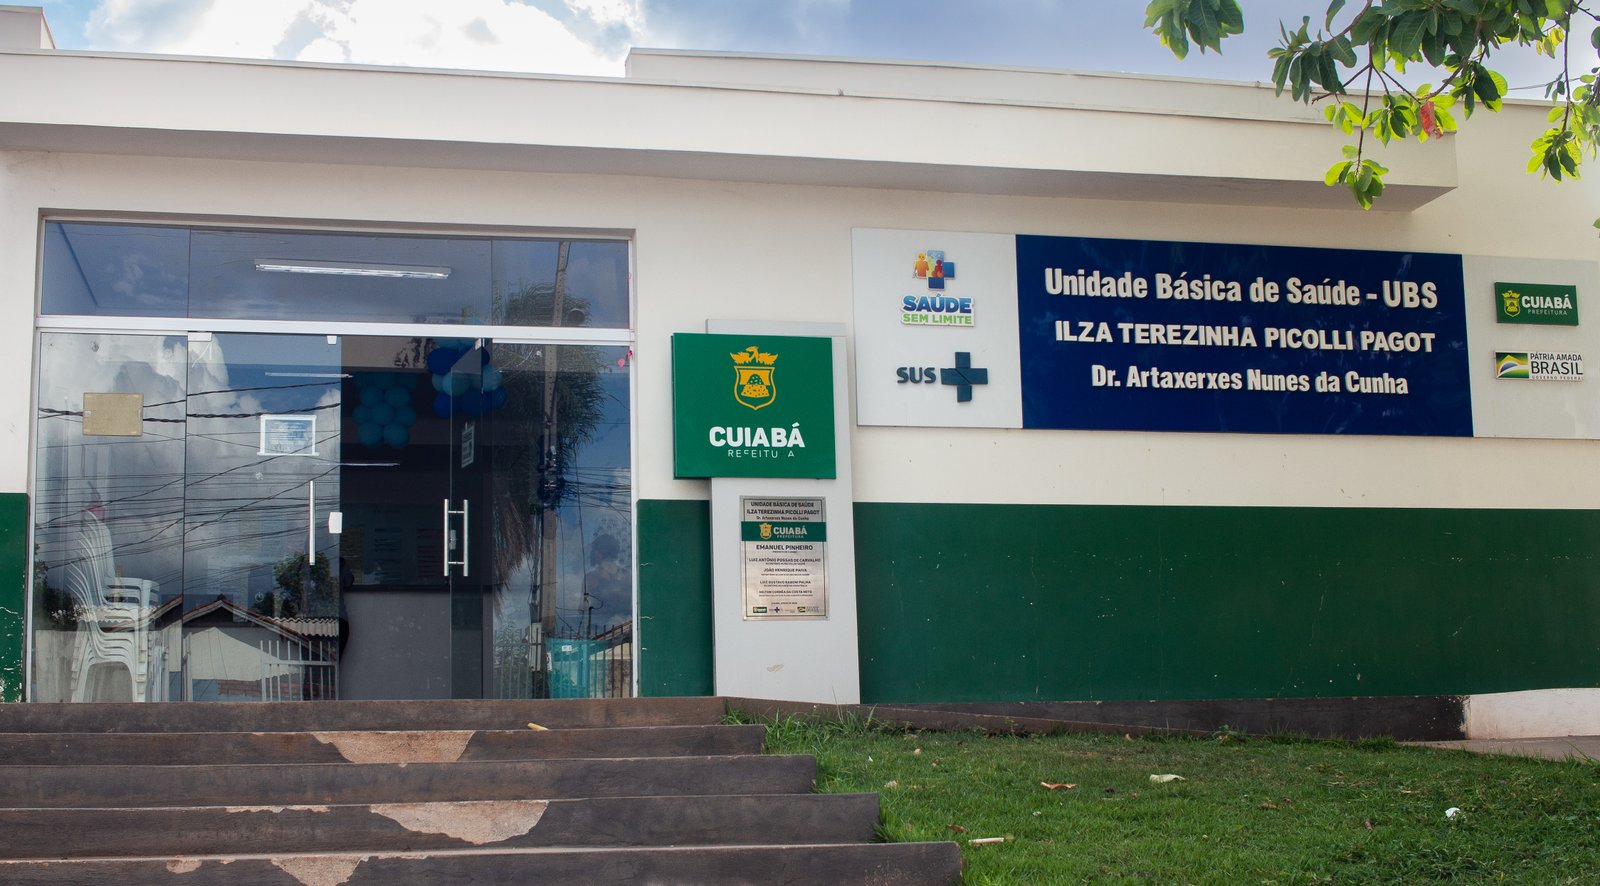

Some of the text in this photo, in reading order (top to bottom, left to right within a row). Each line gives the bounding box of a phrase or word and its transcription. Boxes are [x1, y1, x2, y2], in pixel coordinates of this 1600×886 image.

[1044, 267, 1148, 298] Unidade
[1155, 271, 1242, 302] Básica
[1249, 276, 1280, 303] de
[1286, 277, 1361, 306] Saúde
[1383, 280, 1438, 309] UBS
[902, 293, 972, 314] SAÚDE
[1521, 293, 1573, 310] CUIABÁ
[902, 313, 972, 325] SEM LIMITE
[1055, 320, 1436, 353] ILZA TEREZINHA PICOLLI PAGOT
[1530, 352, 1583, 362] PÁTRIA AMADA
[896, 366, 937, 384] SUS
[1531, 361, 1584, 376] BRASIL
[1091, 364, 1409, 395] Dr. Artaxerxes Nunes da Cunha
[708, 422, 806, 448] CUIABÁ
[773, 525, 807, 535] CUIABÁ
